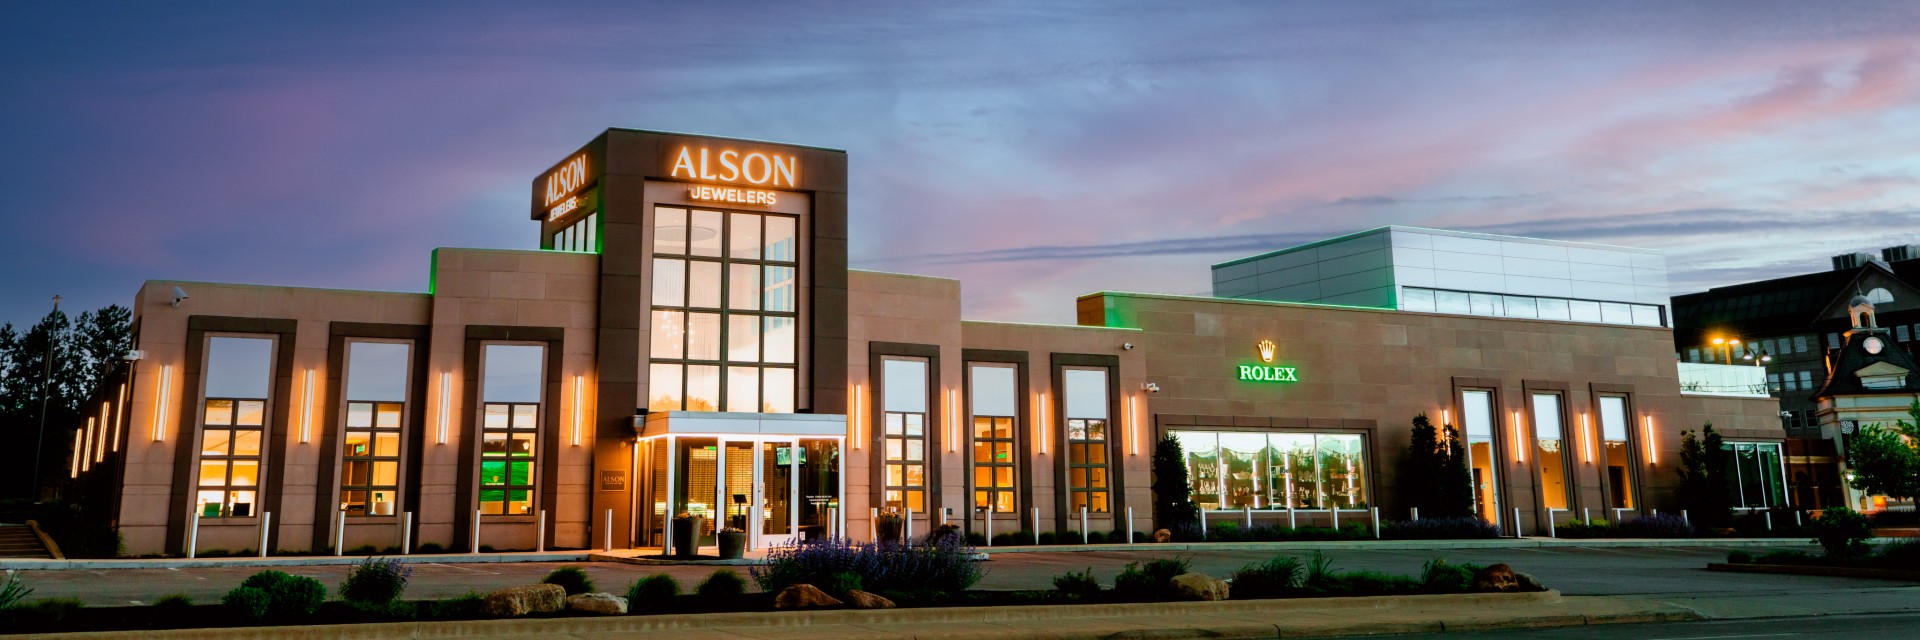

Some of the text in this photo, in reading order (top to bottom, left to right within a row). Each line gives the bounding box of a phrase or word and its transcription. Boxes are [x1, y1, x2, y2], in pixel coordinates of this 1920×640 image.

[544, 154, 586, 207] ALSON
[671, 146, 796, 188] ALSON
[690, 186, 777, 205] JEWELERS
[1239, 365, 1298, 382] ROLEX
